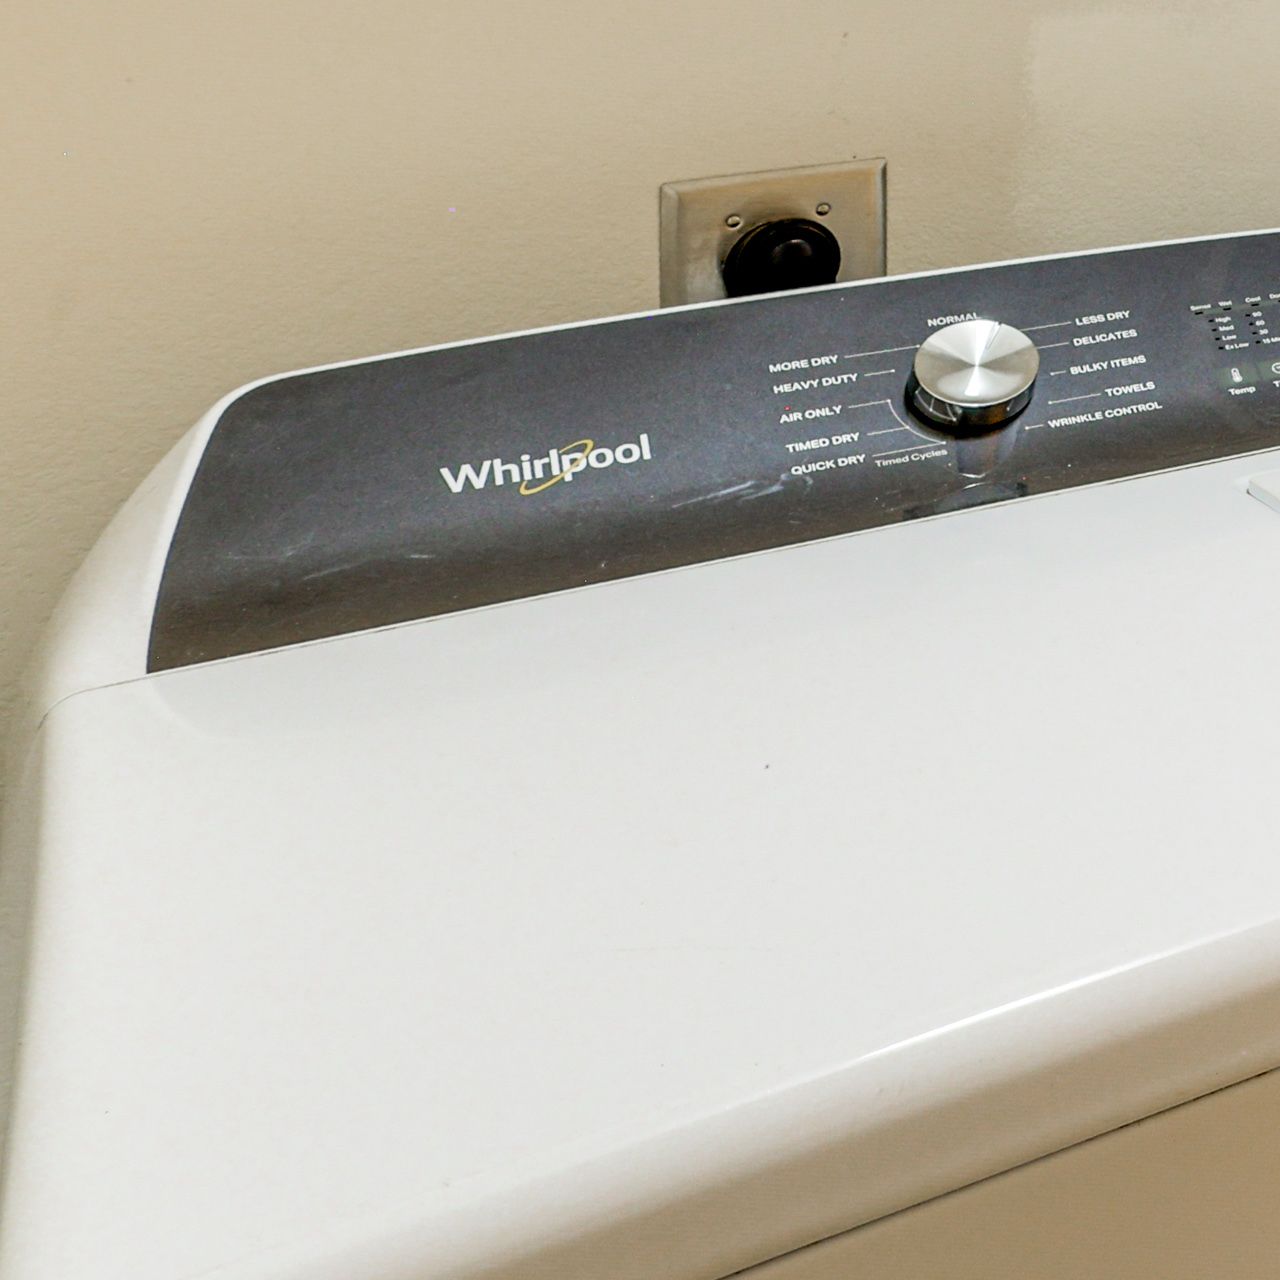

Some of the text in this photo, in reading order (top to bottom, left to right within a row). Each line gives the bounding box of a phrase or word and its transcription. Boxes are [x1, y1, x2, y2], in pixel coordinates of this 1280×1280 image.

[927, 312, 980, 327] NORMAL
[1075, 310, 1130, 326] LESS DRY
[1073, 329, 1138, 347] DELICATES
[768, 355, 839, 373] MORE DRY
[1070, 354, 1147, 375] BULKY ITEMS
[773, 373, 858, 394] HEAVY DUTY
[1104, 381, 1156, 397] TOWELS
[1228, 385, 1256, 396] Temp
[779, 404, 843, 424] AIR ONLY
[1048, 401, 1163, 429] WRINKLE CONTROL
[785, 432, 860, 453] TIMED DRY
[439, 433, 652, 494] Whirlpool
[790, 454, 866, 475] QUICK DRY
[875, 449, 948, 467] Timed Cycles
